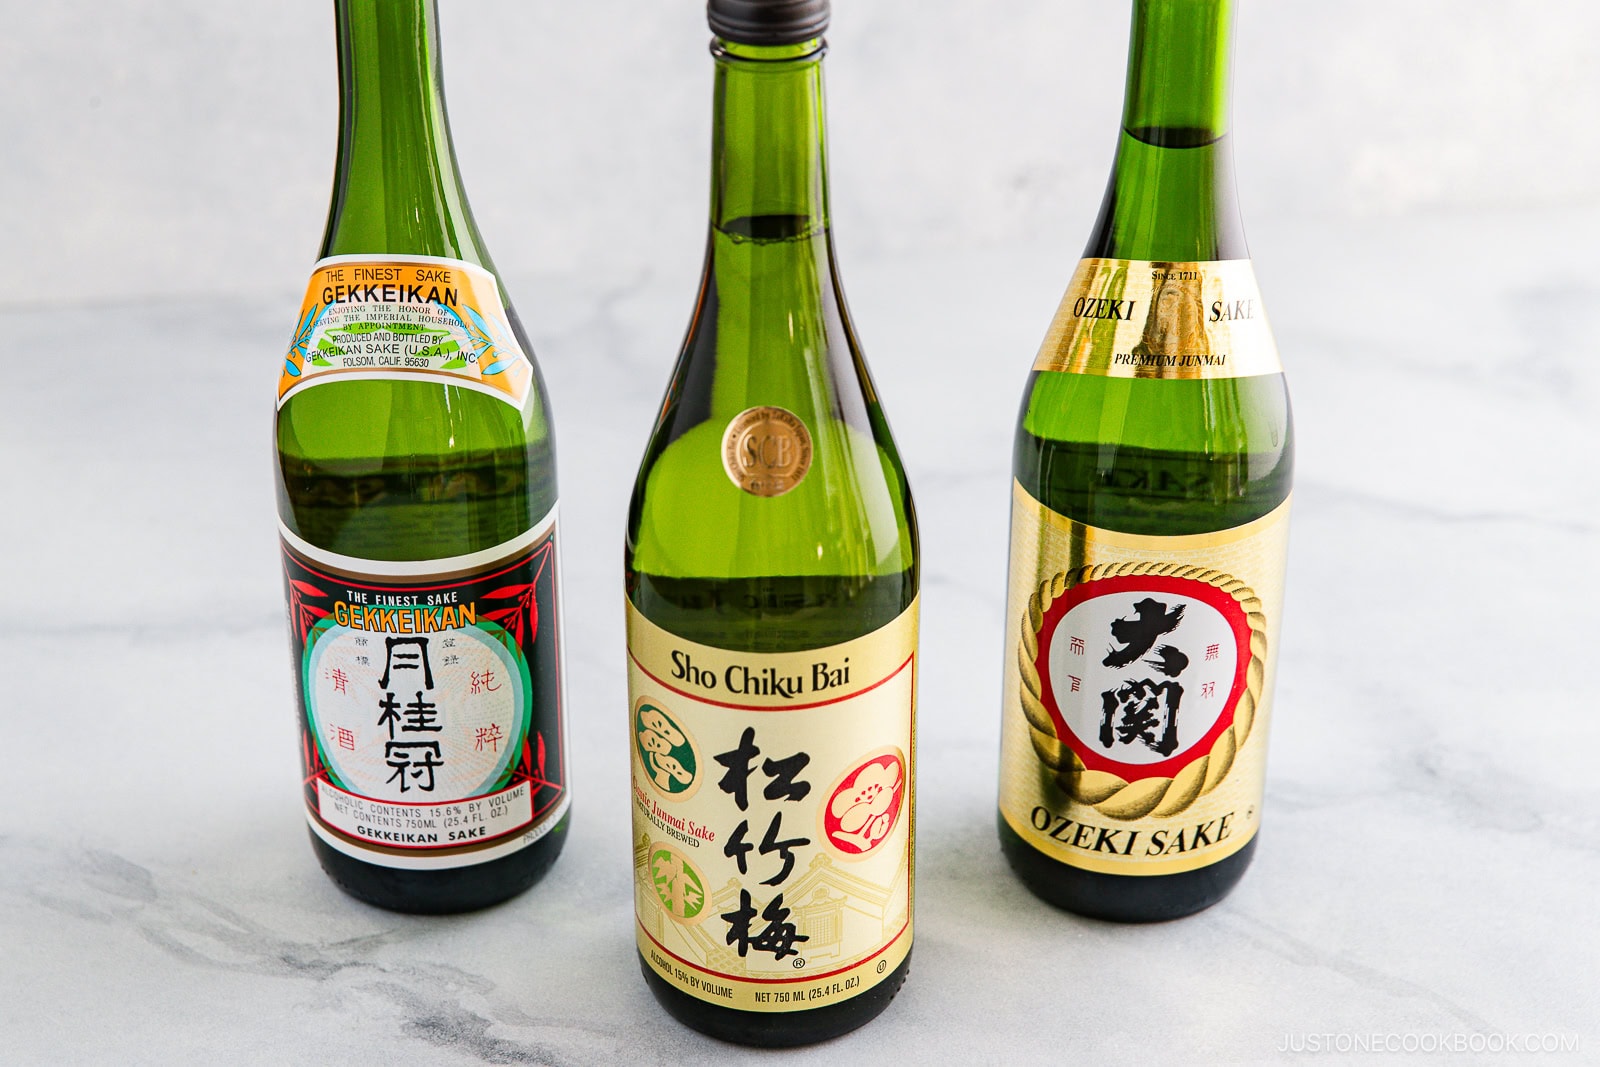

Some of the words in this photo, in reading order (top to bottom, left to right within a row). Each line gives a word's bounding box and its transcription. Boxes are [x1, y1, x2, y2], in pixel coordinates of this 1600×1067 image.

[326, 269, 344, 282] THE
[354, 268, 402, 281] FINEST
[416, 270, 451, 283] SAKE
[1179, 271, 1198, 281] 1711
[322, 284, 458, 306] GEKKEIKAN
[328, 305, 366, 316] ENJOYING
[372, 304, 391, 312] THE
[398, 305, 431, 315] HONOR
[437, 307, 448, 316] OF
[1073, 297, 1136, 321] OZEKI
[343, 322, 353, 331] BY
[358, 321, 426, 331] APPOINTMENT
[344, 314, 361, 322] THE
[366, 313, 412, 322] IMPERIAL
[418, 315, 470, 329] HOUSEHOLD
[332, 333, 372, 344] PRODUCED
[373, 332, 391, 342] AND
[393, 332, 431, 344] BOTTLED
[432, 335, 444, 345] BY
[305, 344, 362, 363] GEKKEIKAN
[365, 343, 400, 354] SAKE
[404, 343, 452, 361] (U.S.A.),
[456, 351, 478, 365] INC.
[378, 356, 402, 366] CALIF.
[404, 357, 429, 368] 95630
[1114, 352, 1176, 367] PREMIUM
[1179, 353, 1226, 367] JUNMAI
[743, 433, 792, 468] SCB
[347, 590, 368, 605] THE
[376, 595, 418, 607] FINEST
[427, 591, 458, 606] SAKE
[333, 600, 477, 634] GEKKEIKAN
[671, 649, 717, 689] Sho
[724, 664, 803, 698] Chiku
[811, 657, 850, 692] Bai
[1099, 597, 1190, 757] 大関
[377, 636, 444, 793] 月桂冠
[320, 784, 364, 810] ALCOHOLIC
[370, 804, 421, 818] CONTENTS
[430, 806, 462, 818] 15.6%
[468, 802, 482, 813] BY
[488, 786, 525, 808] VOLUME
[334, 802, 349, 815] NET
[353, 809, 402, 828] CONTENTS
[406, 819, 437, 829] 750ML
[443, 815, 469, 829] (25.4
[472, 813, 488, 823] FL.
[490, 805, 509, 819] OZ.)
[651, 800, 686, 832] Junmai
[688, 820, 715, 842] Sake
[357, 825, 438, 843] GEKKEIKAN
[448, 826, 486, 841] SAKE
[666, 825, 700, 848] BREWED
[1030, 805, 1143, 856] OZEKI
[1145, 812, 1235, 857] SAKE
[713, 726, 812, 961] 松竹梅
[650, 949, 674, 976] ALCOHOL
[674, 967, 689, 984] 15%
[690, 976, 700, 989] BY
[701, 980, 733, 999] VOLUME
[755, 992, 771, 1003] NET
[774, 992, 790, 1003] 750
[793, 991, 806, 1002] ML
[808, 985, 830, 1001] (25.4
[832, 983, 844, 995] FL.
[845, 975, 860, 990] OZ.)
